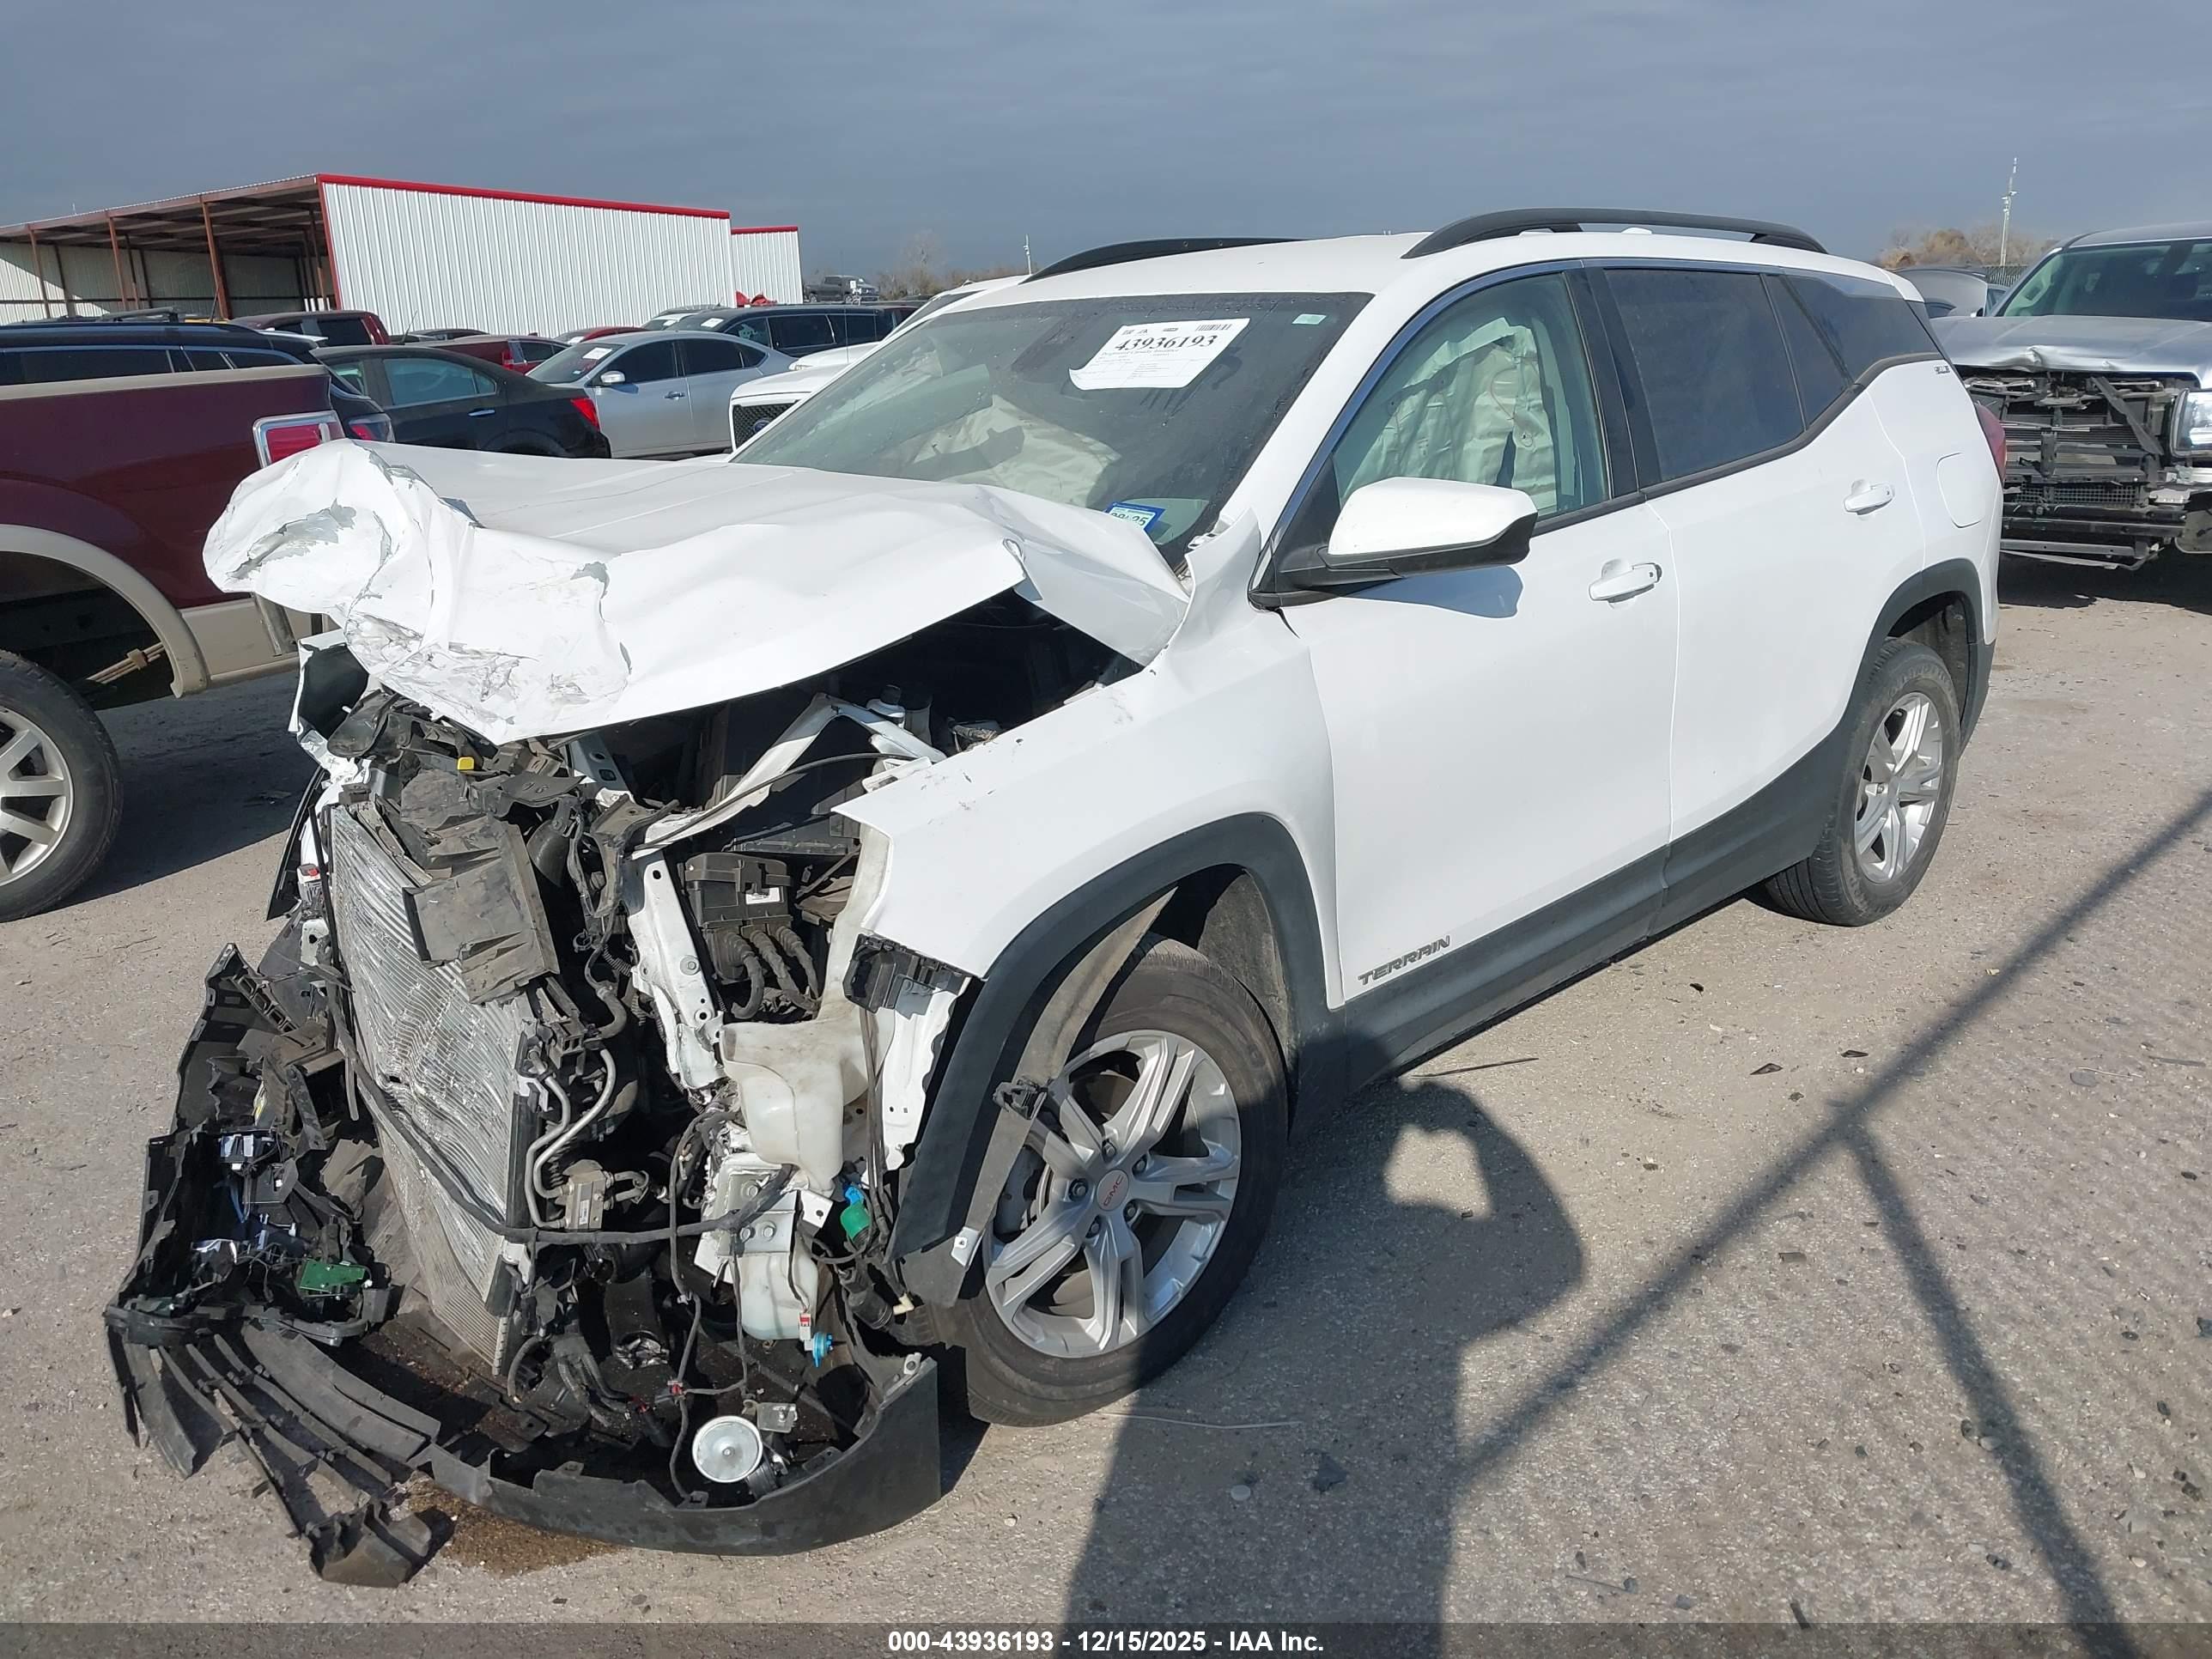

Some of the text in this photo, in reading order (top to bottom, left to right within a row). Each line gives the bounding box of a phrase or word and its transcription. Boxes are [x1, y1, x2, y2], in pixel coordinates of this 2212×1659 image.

[1115, 335, 1218, 350] 43936193
[1358, 935, 1451, 986] TERRAIN
[1103, 1175, 1124, 1206] GMC
